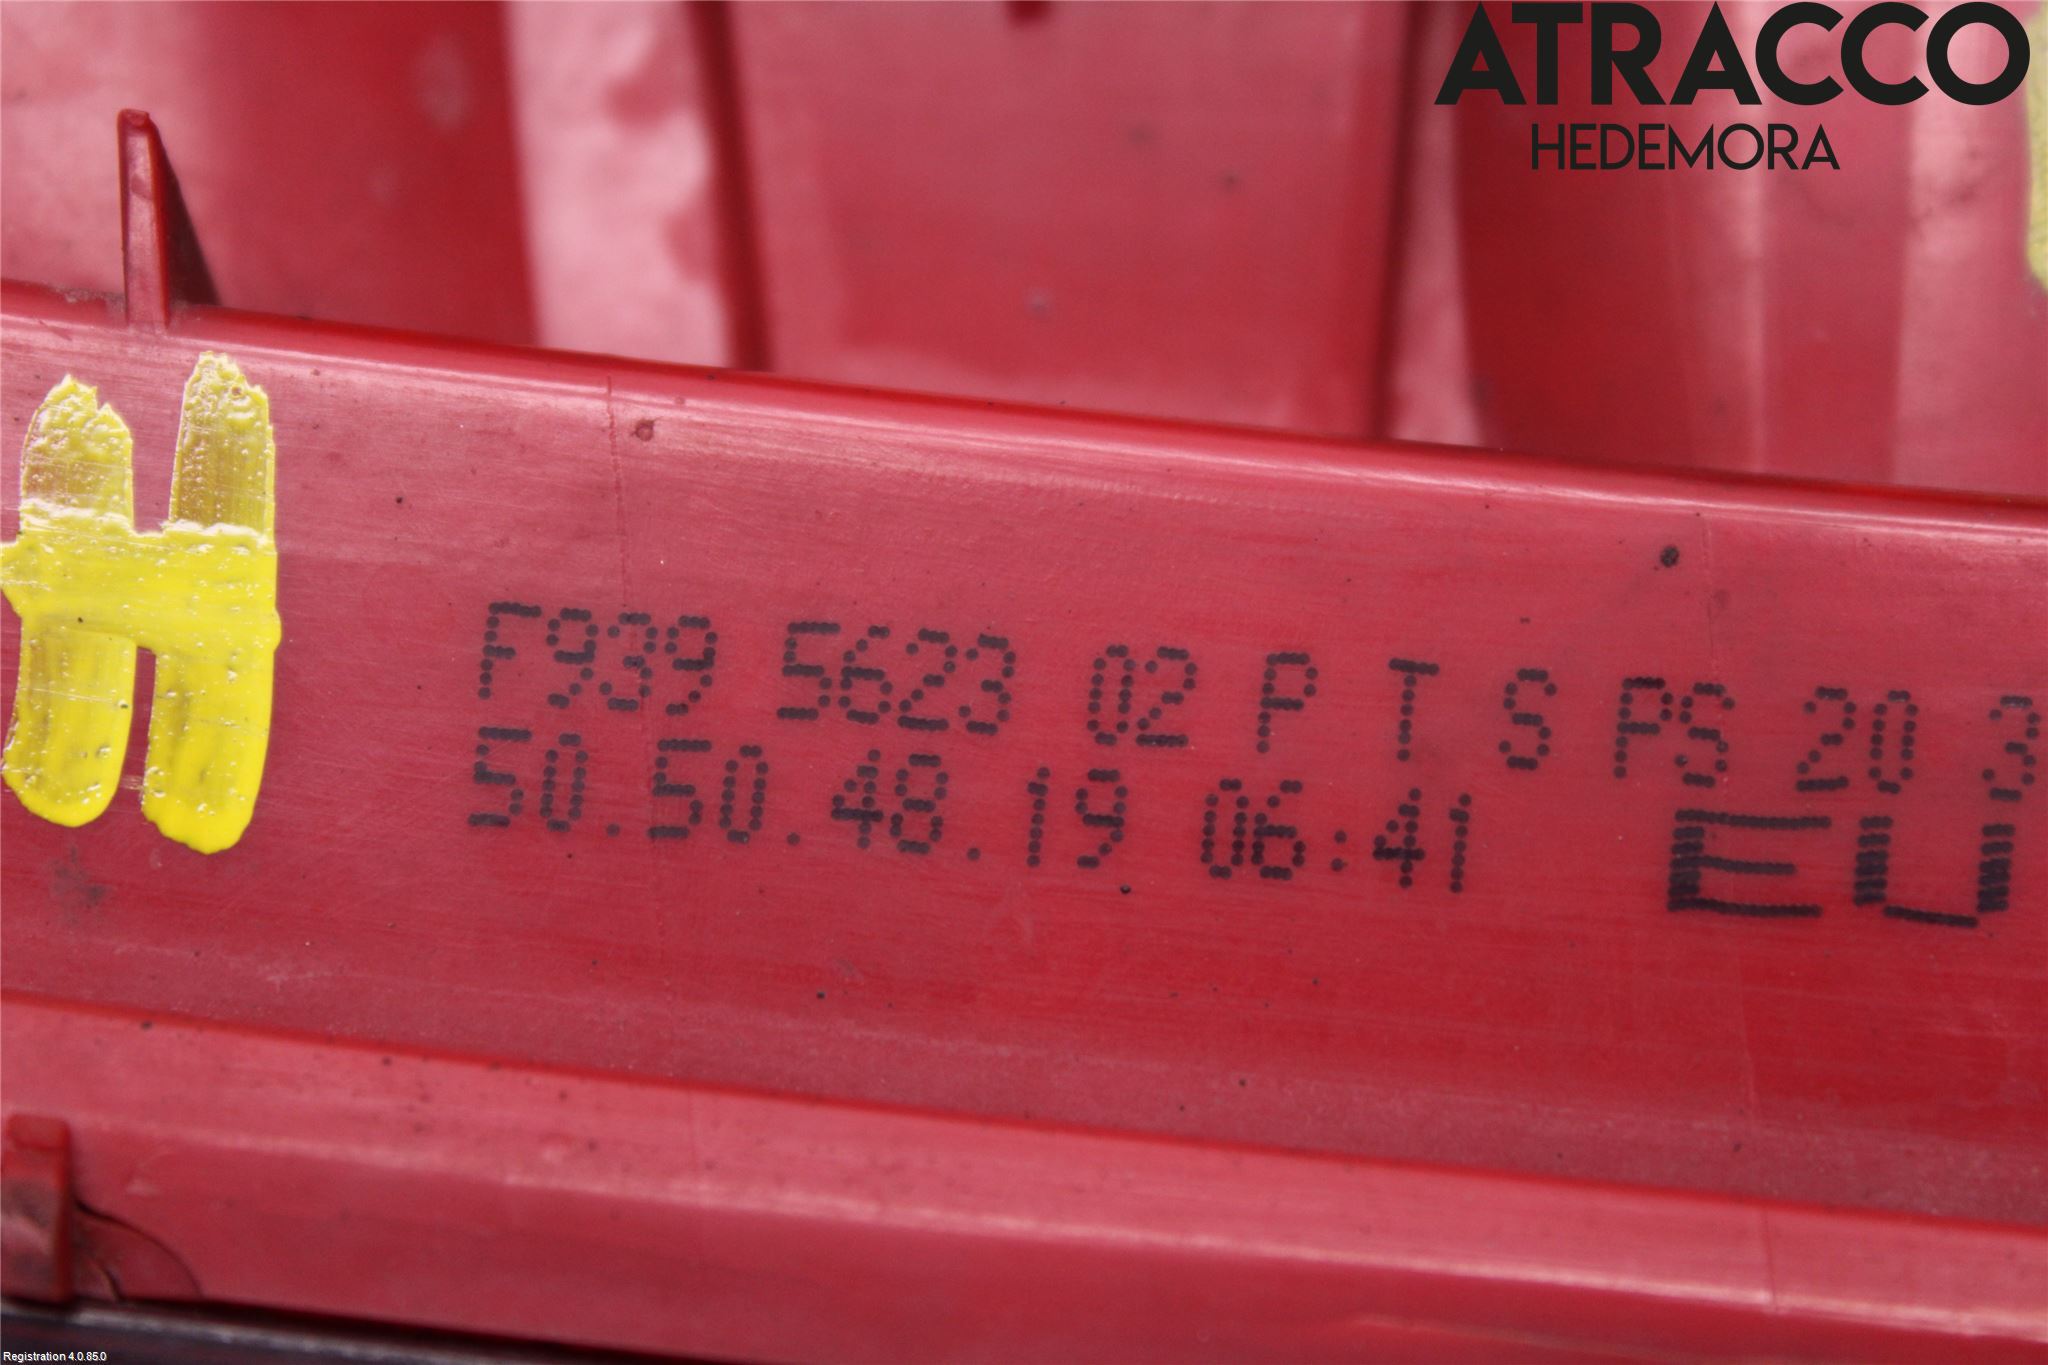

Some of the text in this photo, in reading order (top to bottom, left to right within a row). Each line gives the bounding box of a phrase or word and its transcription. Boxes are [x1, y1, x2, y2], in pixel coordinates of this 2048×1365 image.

[477, 601, 2042, 802] F939 5623 02 P T S PS 20 3
[467, 725, 1473, 895] 50.50.48.19 06:41
[1666, 807, 2017, 929] EU
